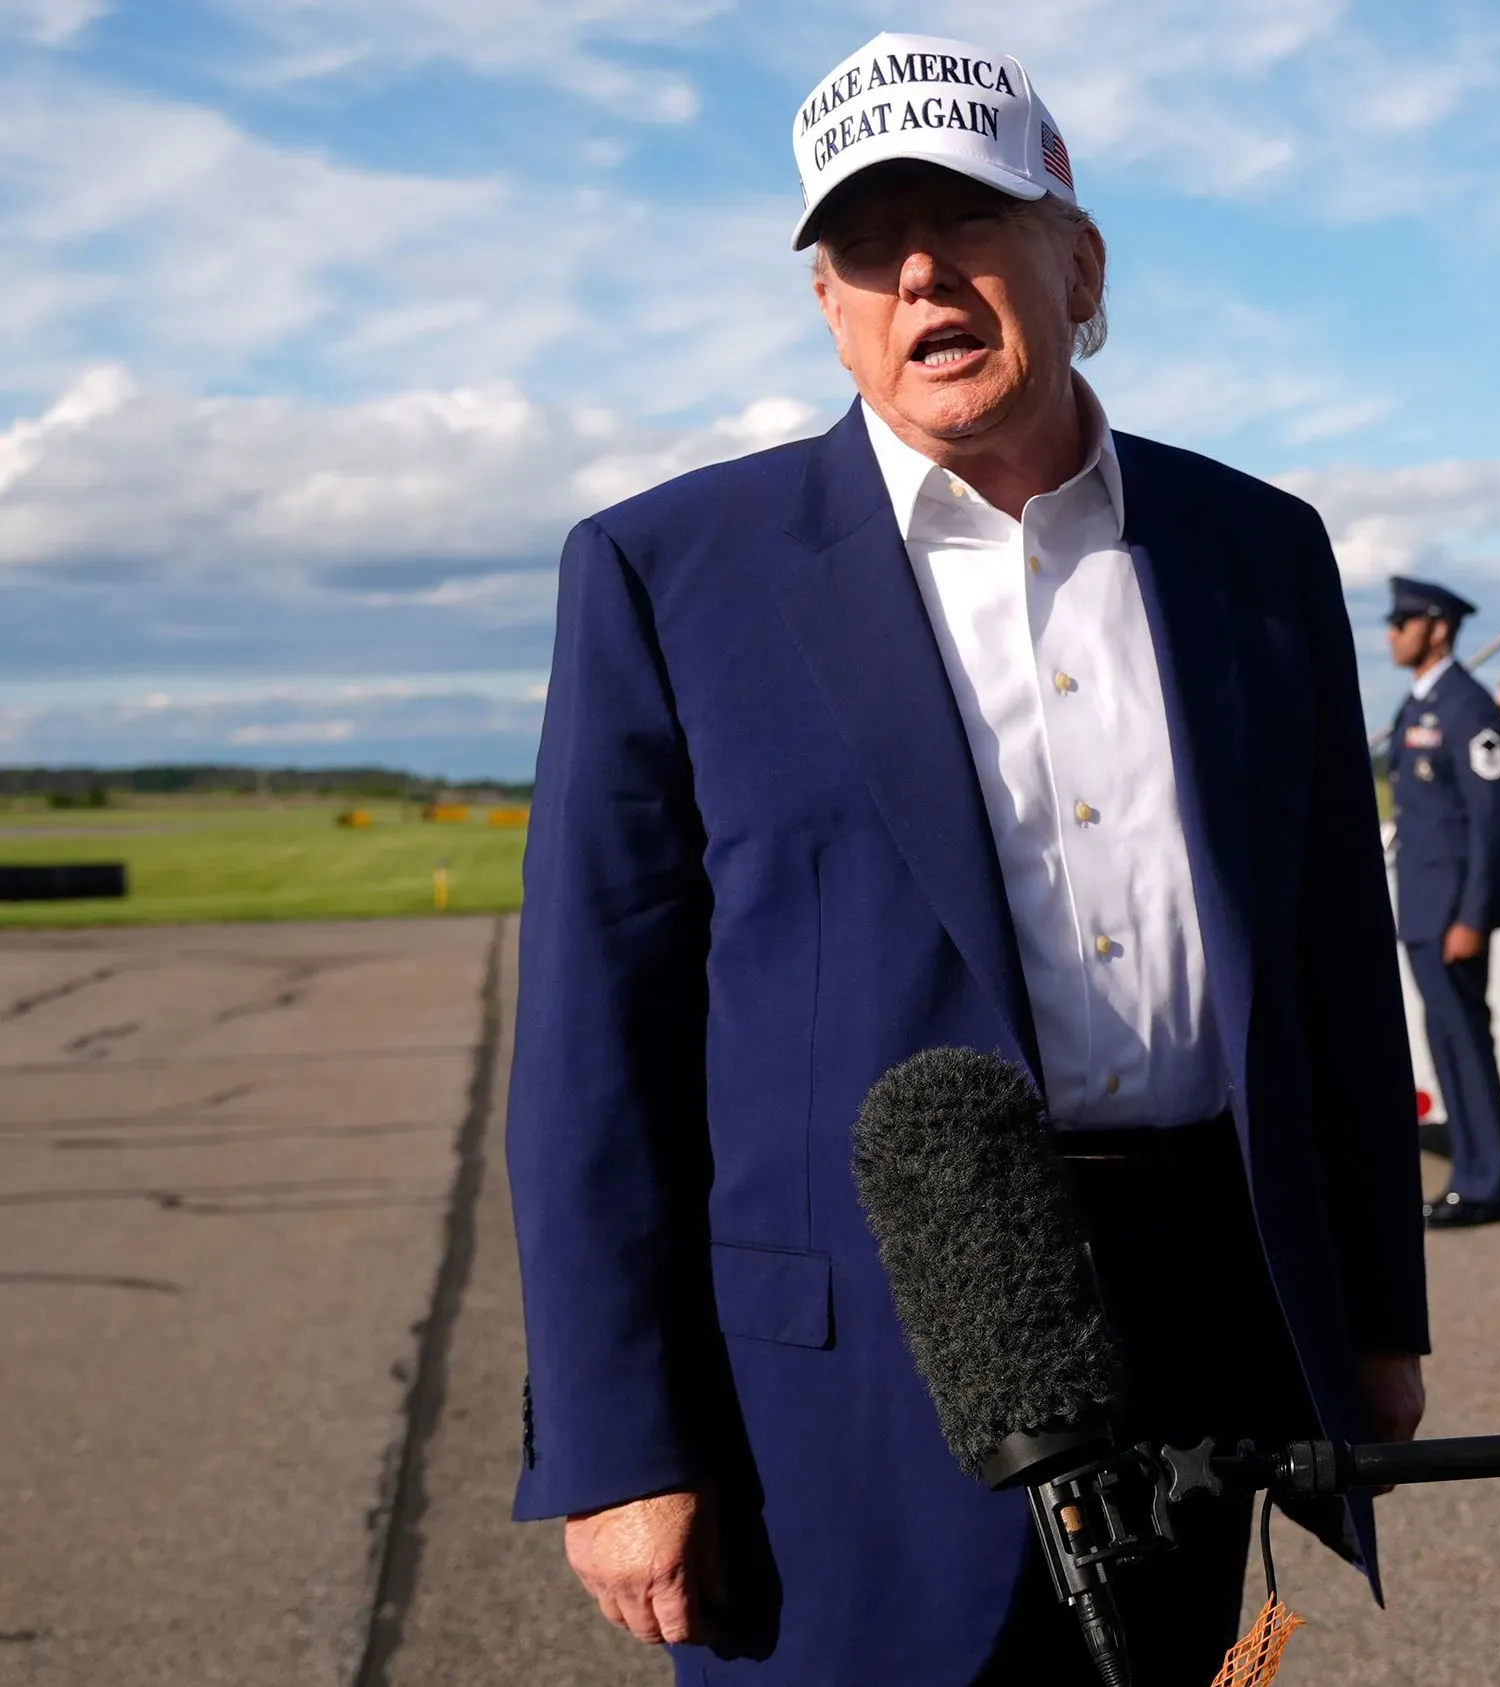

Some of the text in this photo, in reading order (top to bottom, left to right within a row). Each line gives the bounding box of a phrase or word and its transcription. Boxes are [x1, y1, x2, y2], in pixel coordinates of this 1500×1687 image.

[800, 53, 1016, 137] MAKE AMERICA
[814, 98, 1000, 171] GREAT AGAIN
